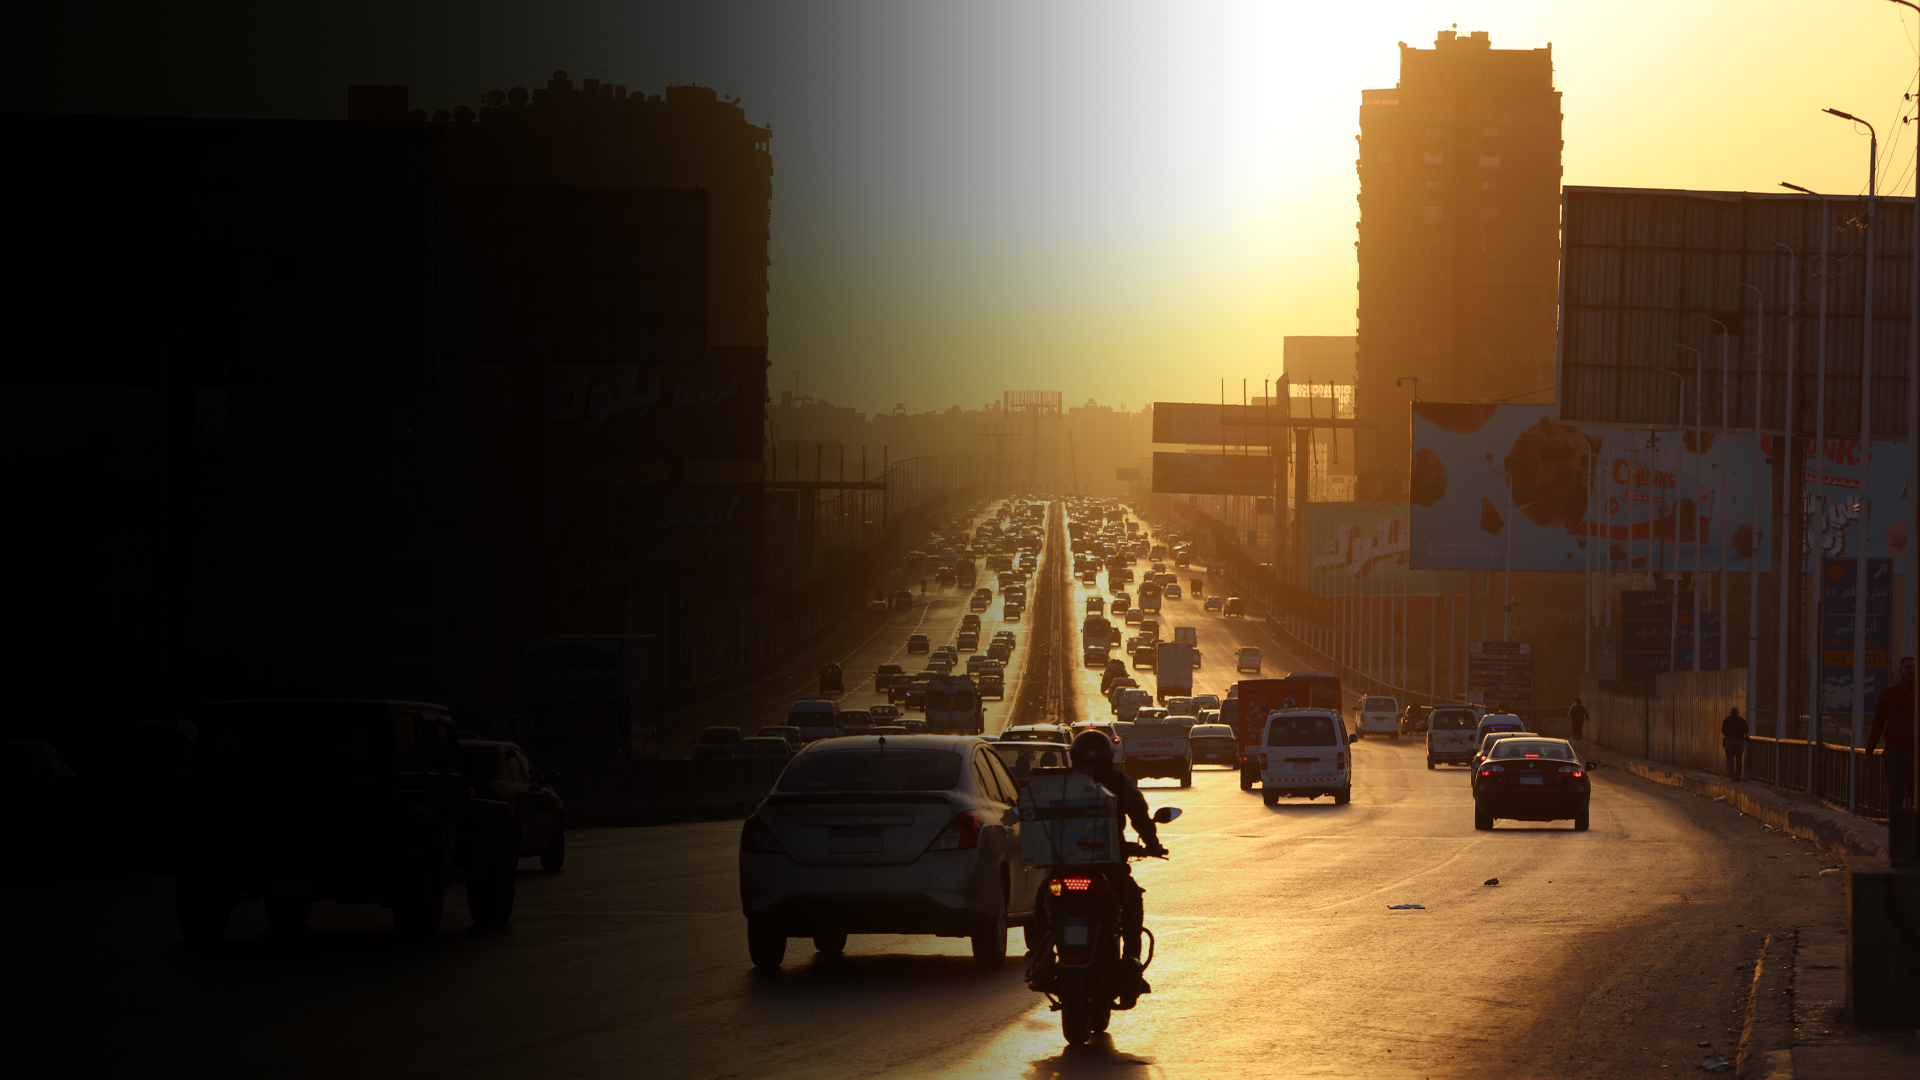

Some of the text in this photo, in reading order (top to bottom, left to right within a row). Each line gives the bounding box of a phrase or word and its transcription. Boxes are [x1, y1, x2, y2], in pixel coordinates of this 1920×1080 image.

[1825, 586, 1838, 597] 26
[1827, 601, 1847, 612] Exit
[1872, 602, 1885, 612] 26
